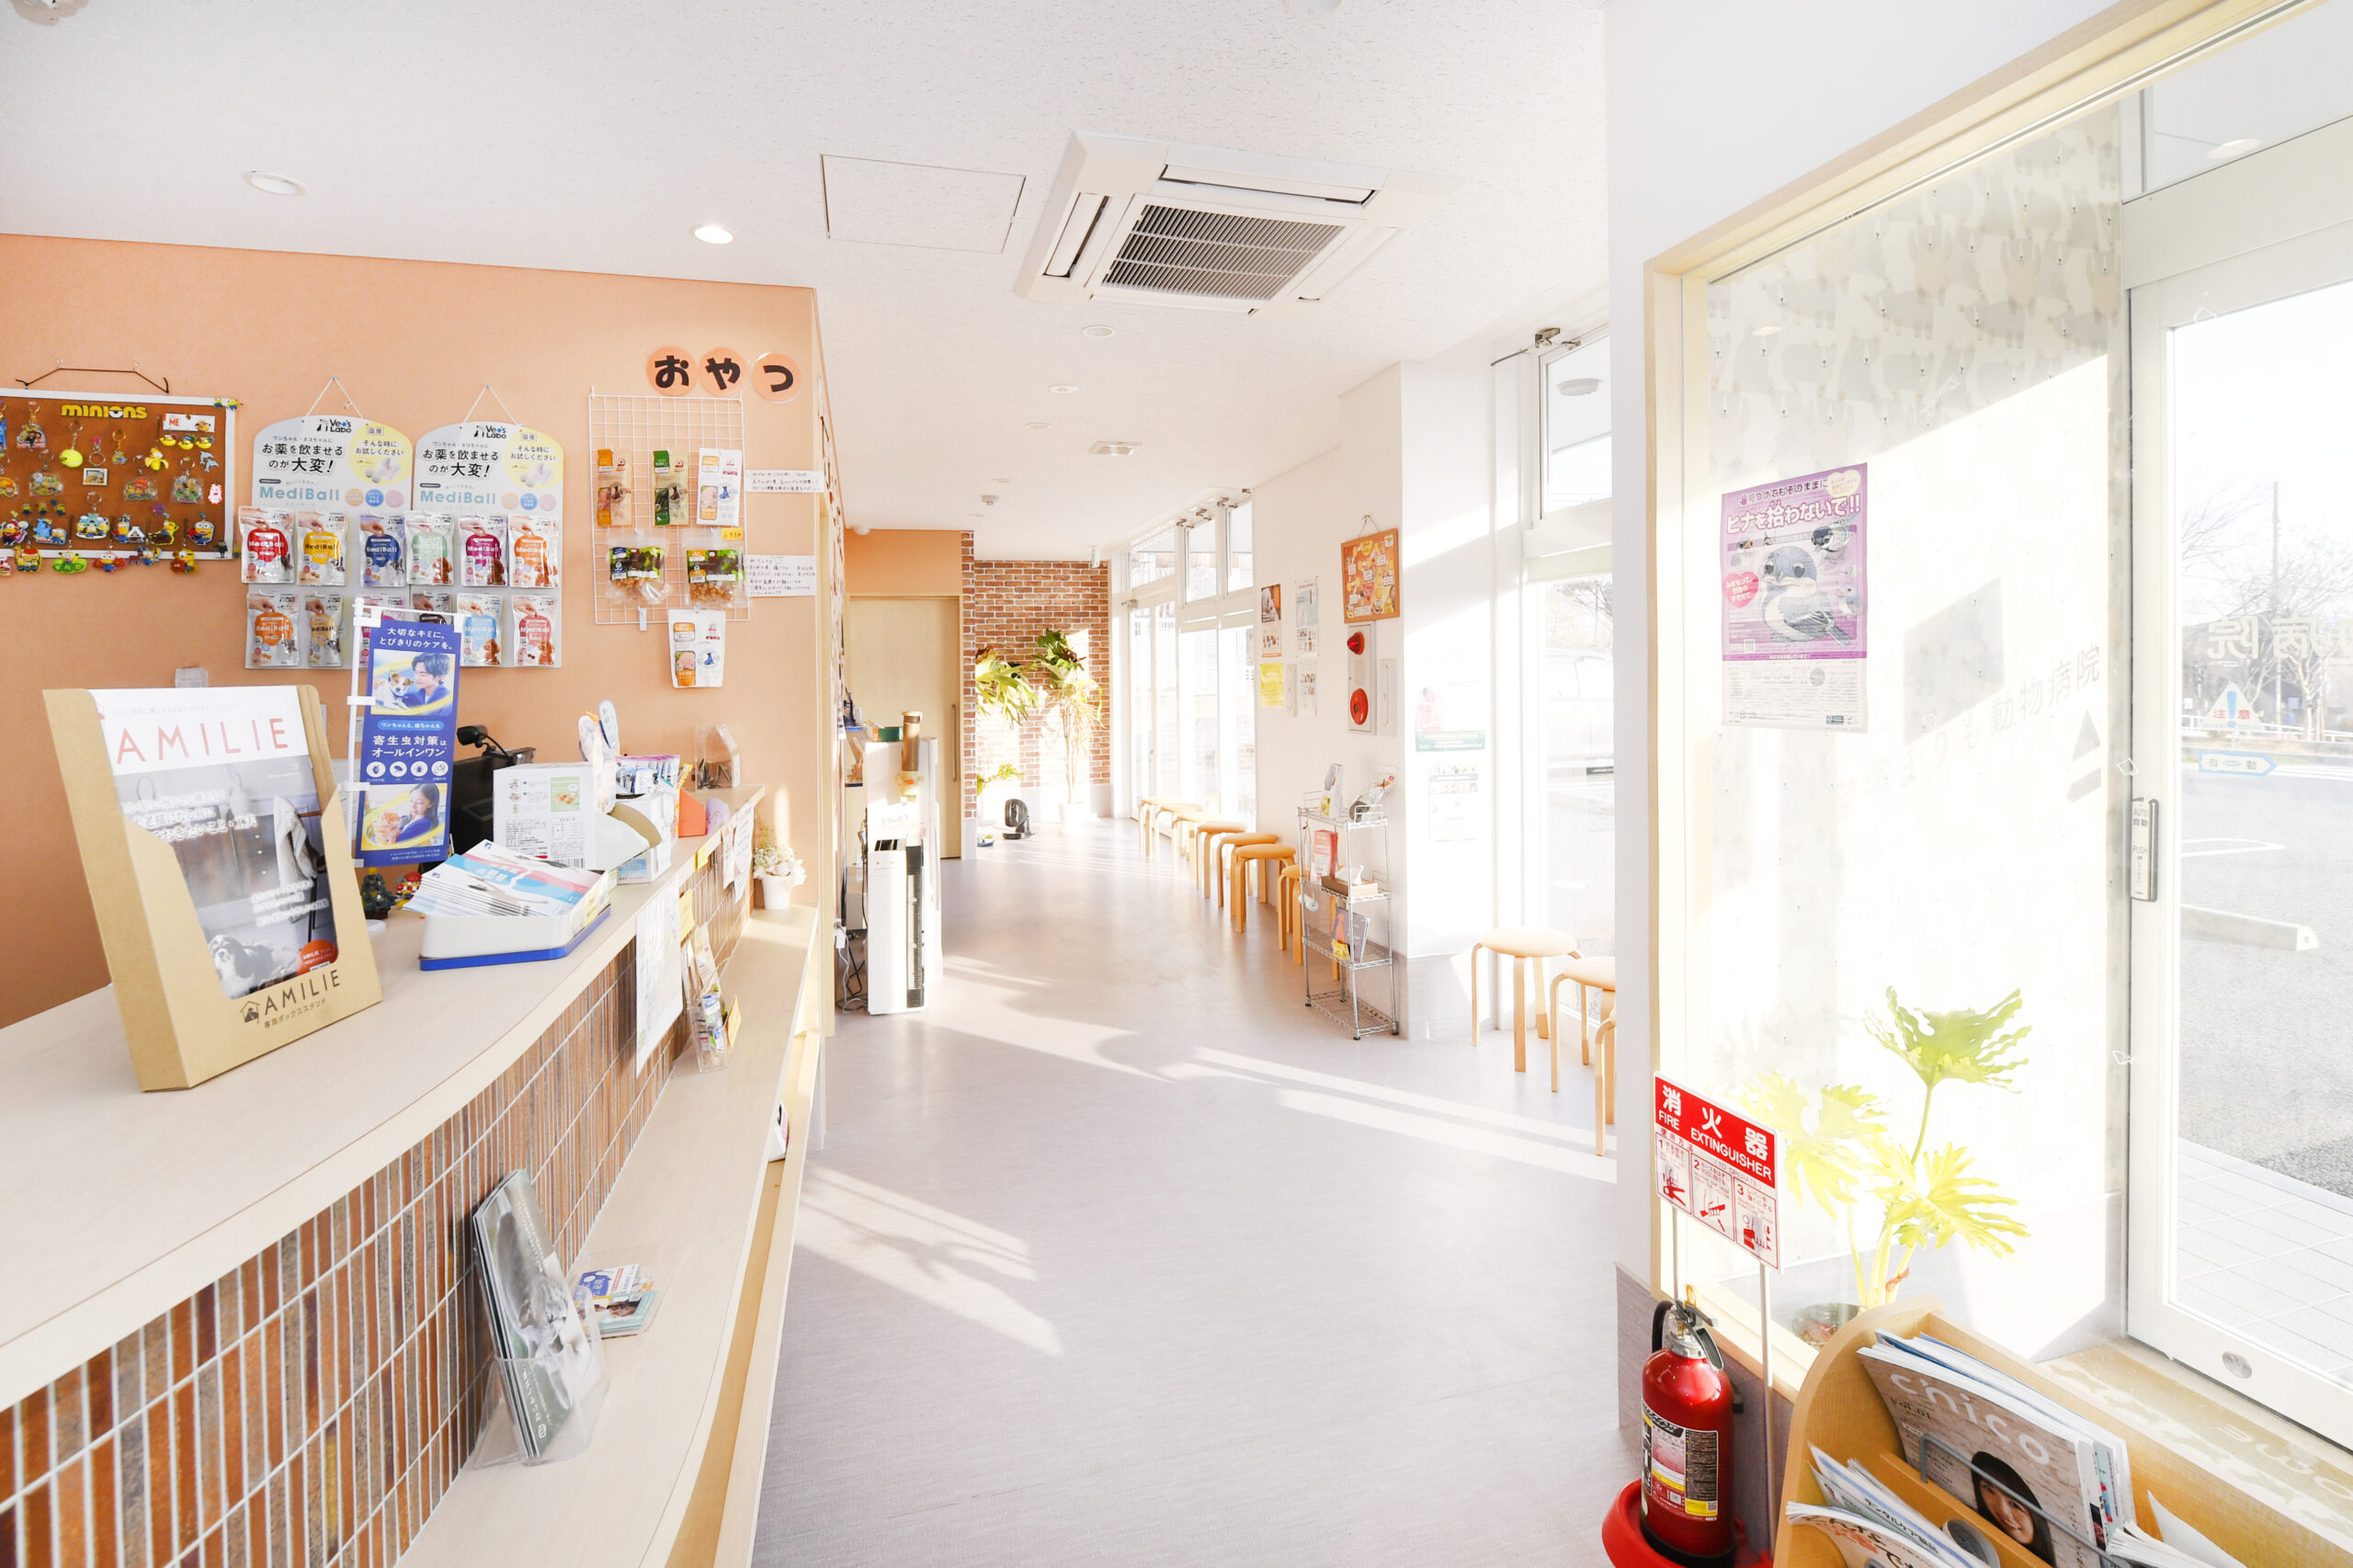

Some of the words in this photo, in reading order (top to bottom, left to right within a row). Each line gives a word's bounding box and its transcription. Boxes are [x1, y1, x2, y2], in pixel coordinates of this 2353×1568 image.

[654, 355, 794, 392] おやつ
[262, 443, 344, 456] お薬を飲ませる
[355, 448, 404, 456] お試しください
[423, 449, 499, 461] お薬を飲ませる
[259, 485, 339, 501] MediBall
[419, 490, 496, 505] MediBall
[2212, 708, 2251, 720] 注意
[372, 734, 448, 746] 寄生虫対策は
[371, 747, 446, 758] オールインワン
[2133, 808, 2149, 817] AUTO
[2132, 845, 2148, 854] PUSH
[264, 969, 341, 1017] AMILIE
[1662, 1084, 1768, 1163] 消火器
[1658, 1108, 1681, 1131] FIRE
[1690, 1126, 1773, 1182] EXTINGUISHER
[1693, 1158, 1700, 1171] 2
[1736, 1183, 1745, 1196] 3
